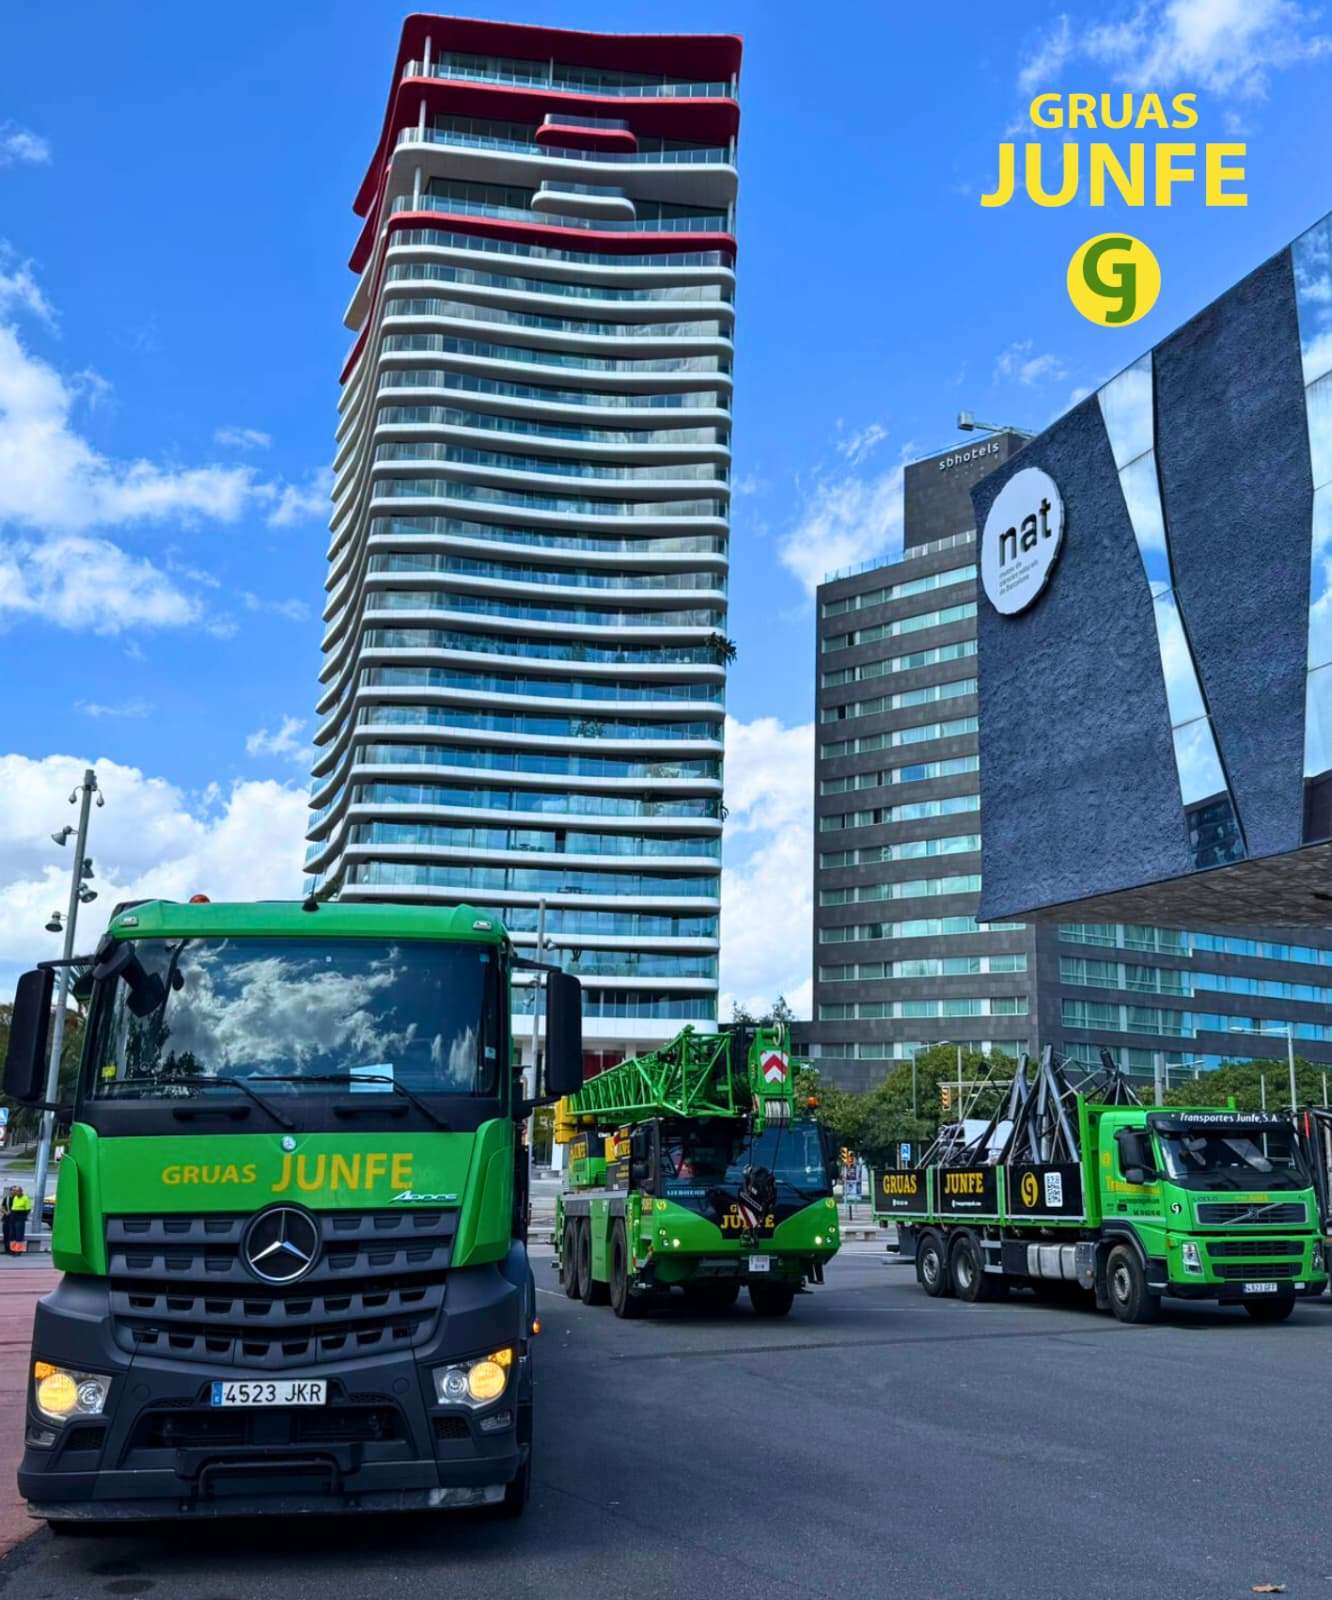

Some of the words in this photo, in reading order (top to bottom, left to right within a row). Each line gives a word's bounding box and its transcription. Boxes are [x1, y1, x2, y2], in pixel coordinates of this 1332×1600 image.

[939, 442, 999, 470] sbhotels
[999, 497, 1052, 567] nat
[1180, 1112, 1234, 1123] Transportes
[161, 1164, 257, 1185] GRUAS
[271, 1152, 413, 1192] JUNFE
[883, 1174, 917, 1194] GRUAS
[944, 1172, 984, 1194] JUNFE
[225, 1384, 276, 1403] 4523
[285, 1383, 321, 1402] JKR
